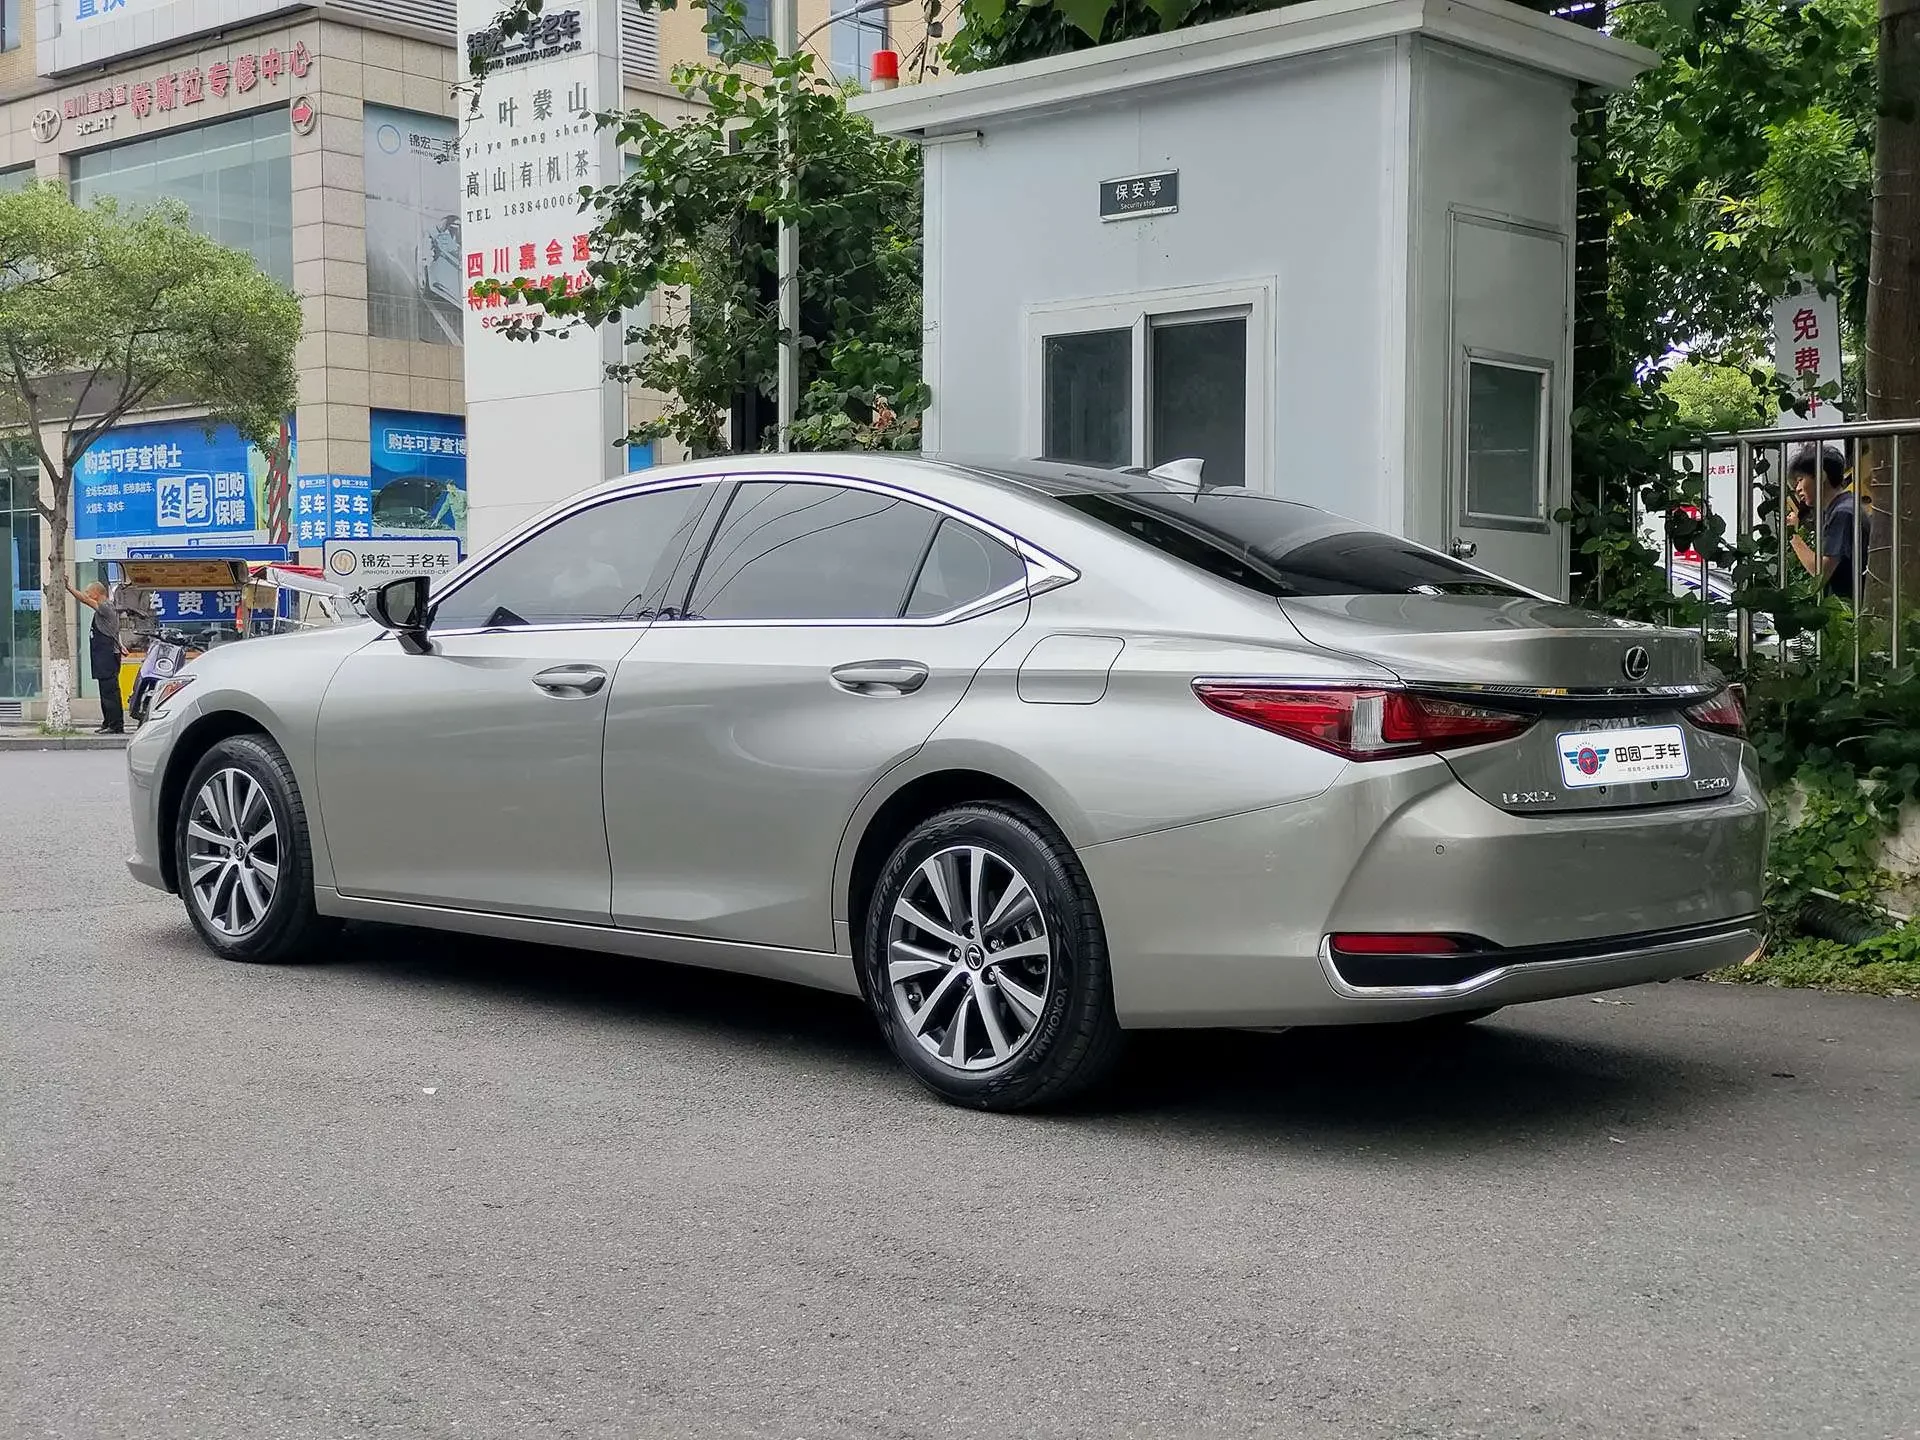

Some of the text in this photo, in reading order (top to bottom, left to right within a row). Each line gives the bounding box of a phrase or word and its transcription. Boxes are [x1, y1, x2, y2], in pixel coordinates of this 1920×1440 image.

[131, 40, 313, 119] 特斯拉专修中心
[466, 143, 478, 159] yi
[555, 123, 589, 138] shan
[1116, 178, 1162, 201] 保安亭
[467, 208, 491, 222] TEL
[84, 443, 183, 475] 购车可享查博士
[215, 472, 245, 498] 回购
[161, 482, 209, 520] 终身
[300, 494, 326, 514] 买车
[334, 494, 369, 515] 买车
[215, 499, 246, 526] 保障
[300, 520, 326, 541] 卖车
[334, 520, 369, 537] 卖车
[361, 553, 450, 568] 锦宏二手名车
[1614, 743, 1681, 763] 田园二手车
